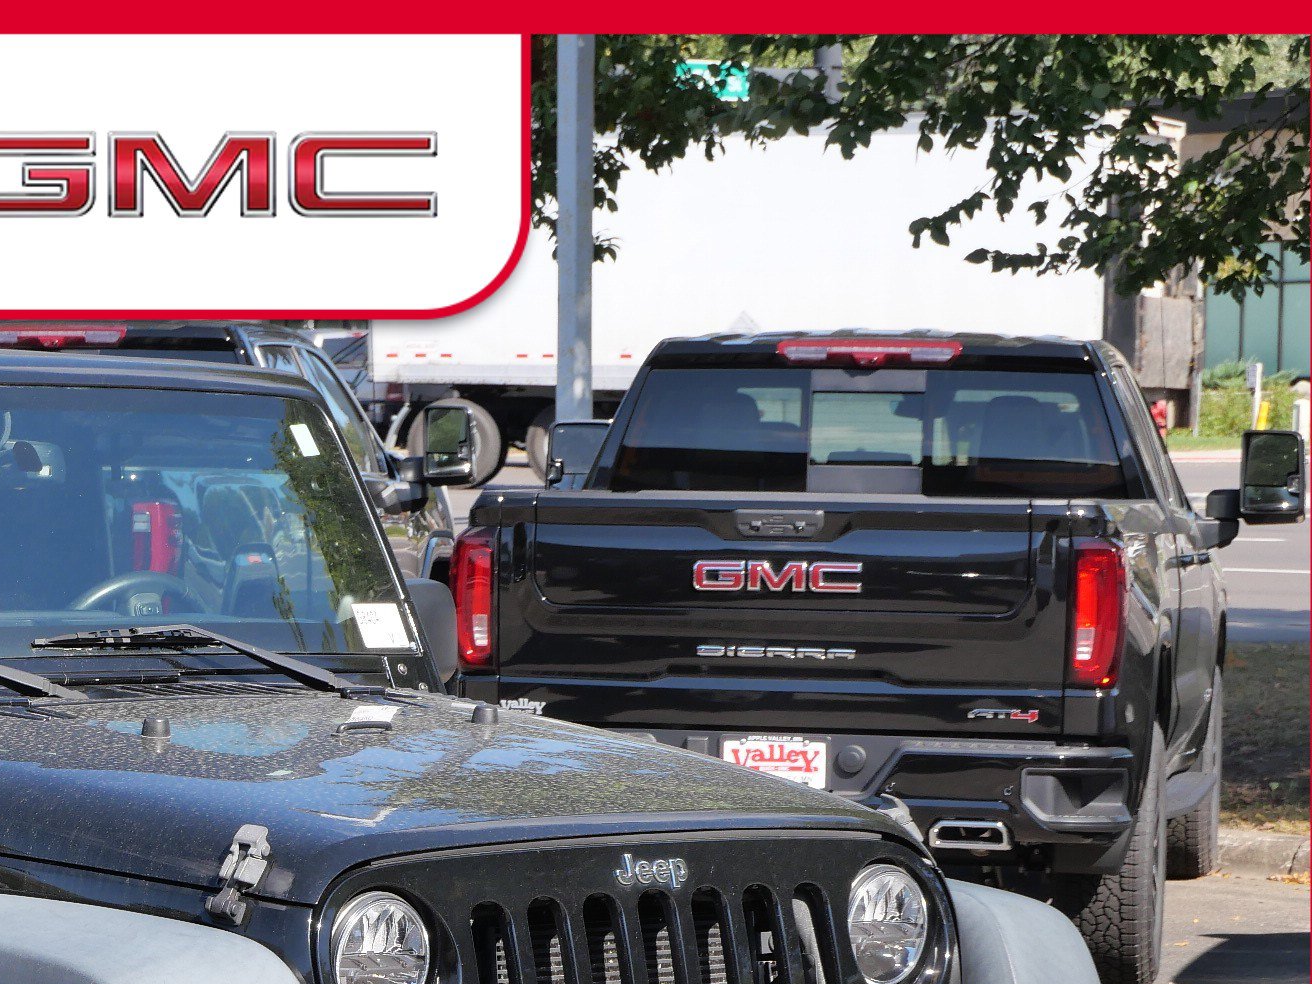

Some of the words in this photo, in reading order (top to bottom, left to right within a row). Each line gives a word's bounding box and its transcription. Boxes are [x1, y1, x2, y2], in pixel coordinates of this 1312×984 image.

[693, 559, 864, 593] GMC
[696, 645, 857, 660] SIERRA
[967, 708, 1039, 723] AT4
[612, 853, 689, 891] Jeep
